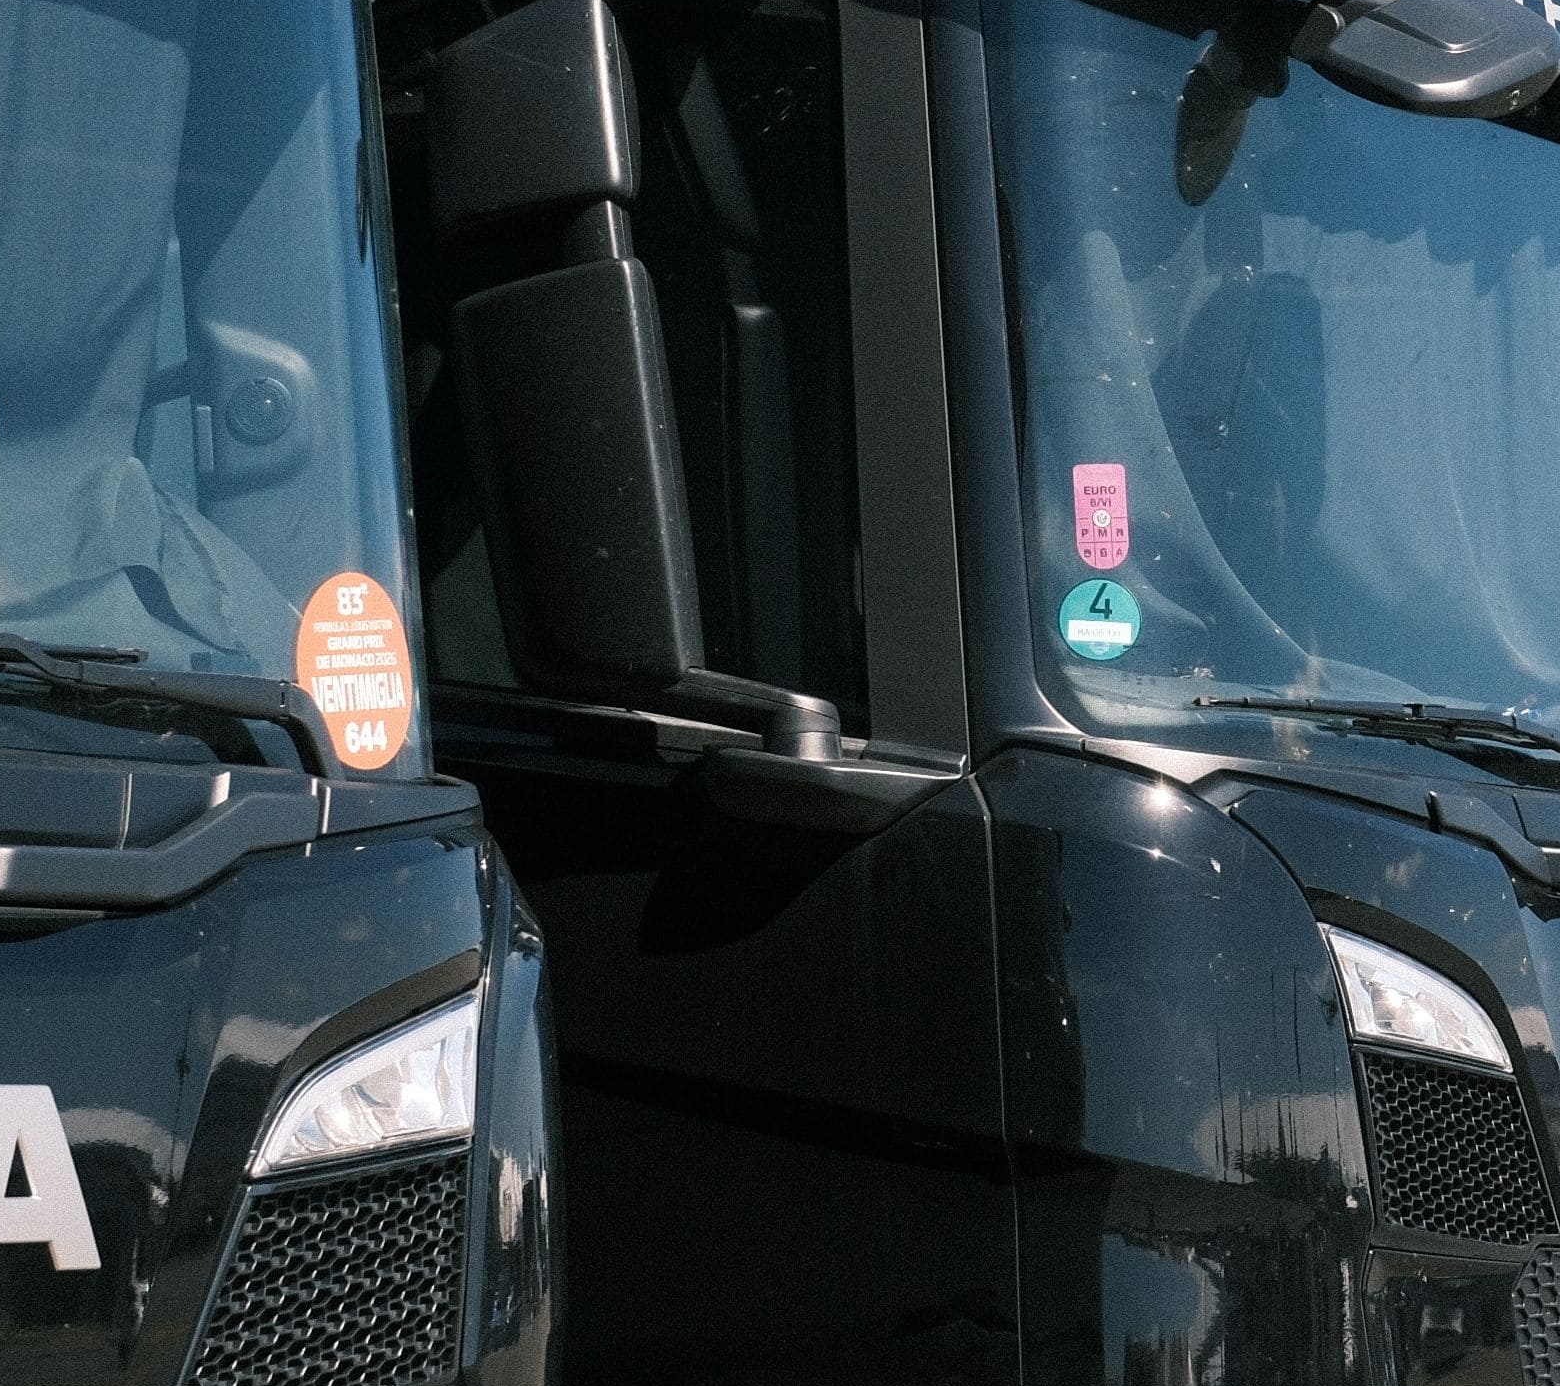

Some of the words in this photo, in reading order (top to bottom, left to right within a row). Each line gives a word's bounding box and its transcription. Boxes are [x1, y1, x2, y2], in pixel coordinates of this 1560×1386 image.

[1083, 485, 1117, 496] EURO
[1089, 582, 1113, 620] 4
[311, 671, 407, 713] VENTIMIGLIA
[344, 719, 388, 754] 644
